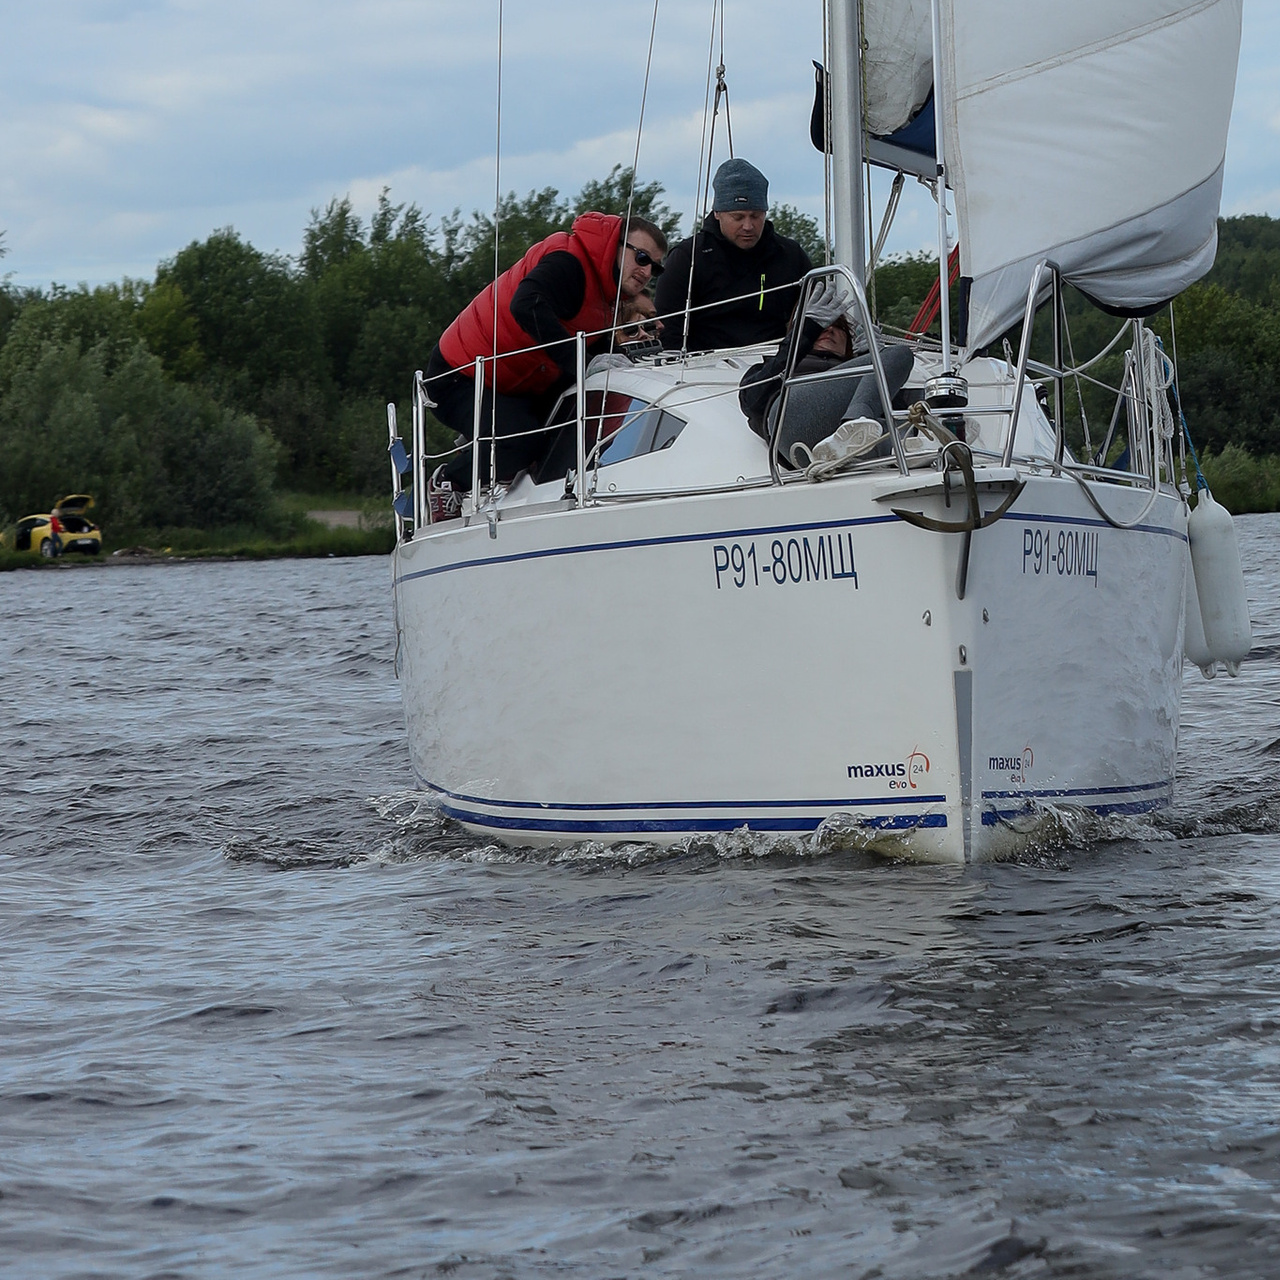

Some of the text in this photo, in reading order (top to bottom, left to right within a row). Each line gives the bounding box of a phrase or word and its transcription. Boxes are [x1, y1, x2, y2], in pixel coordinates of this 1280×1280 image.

[713, 532, 859, 590] Р91-80МЩ
[1022, 528, 1099, 589] Р91-80МЩ
[847, 762, 924, 778] maxus 24
[988, 756, 1021, 771] maxus
[889, 779, 907, 789] evo
